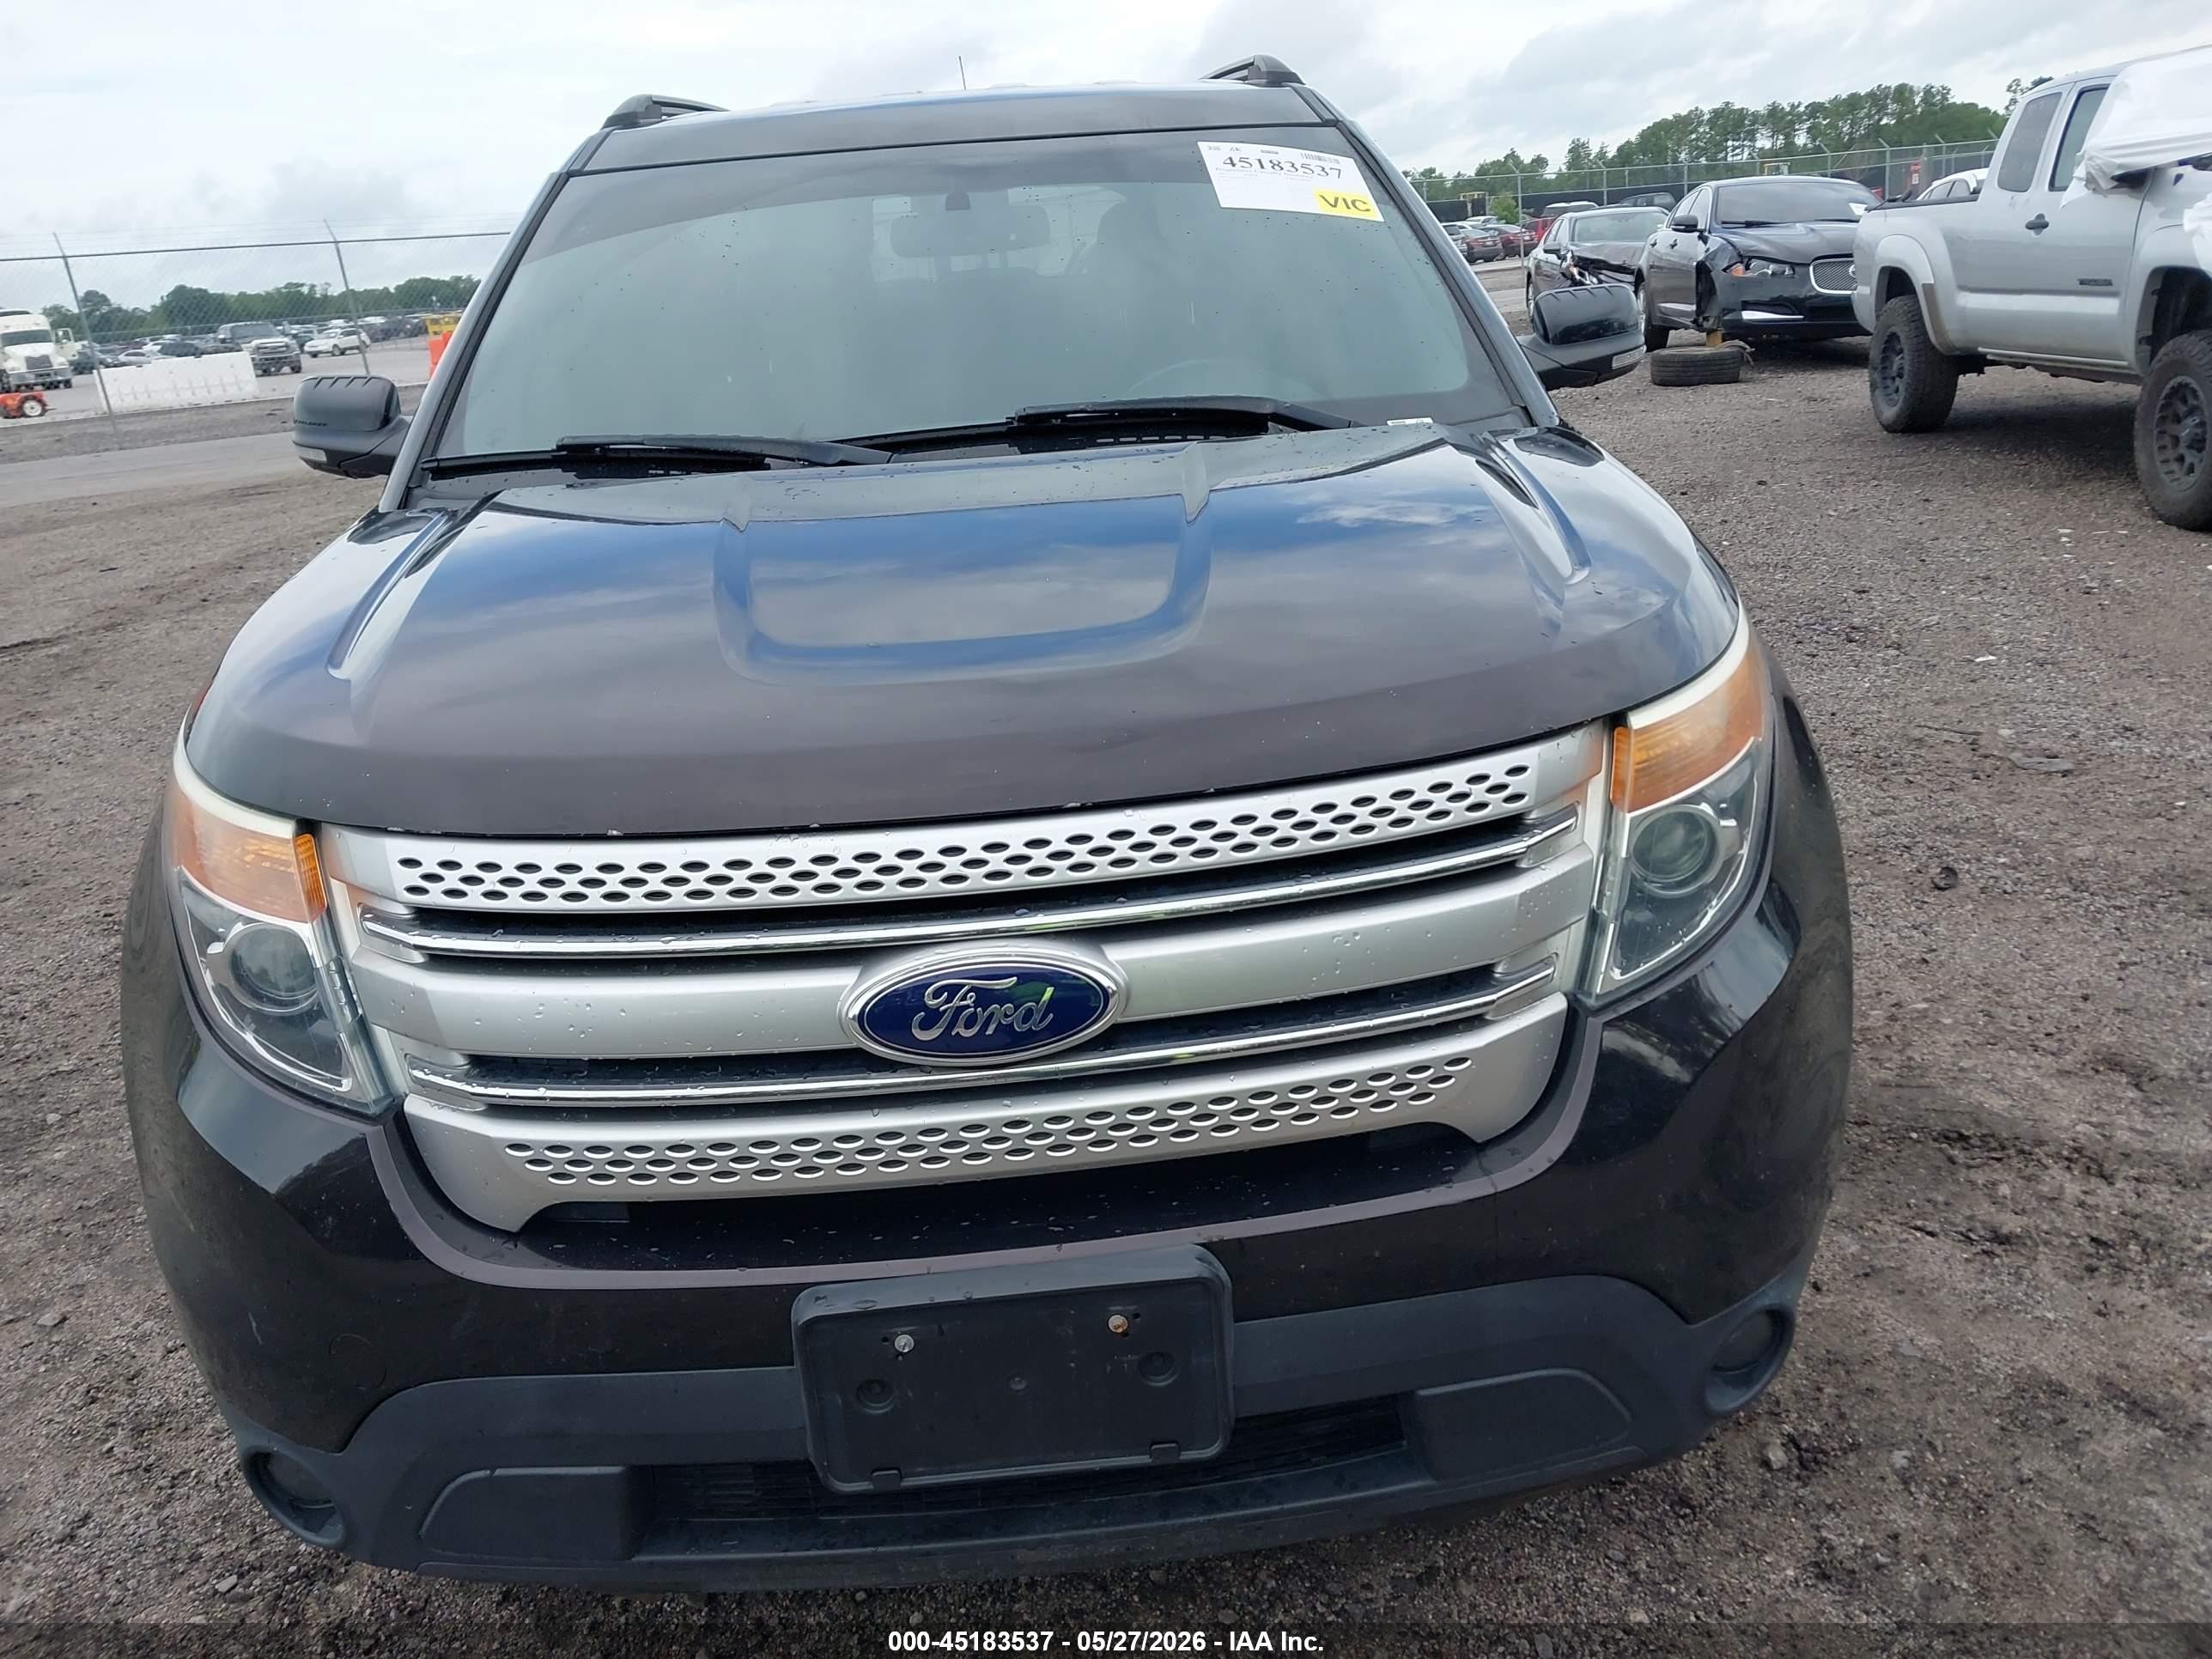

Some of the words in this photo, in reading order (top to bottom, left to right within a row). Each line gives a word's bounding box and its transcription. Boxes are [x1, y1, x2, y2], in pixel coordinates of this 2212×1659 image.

[1223, 156, 1342, 179] 45183537
[1319, 194, 1371, 212] VIC
[911, 976, 1055, 1041] Ford
